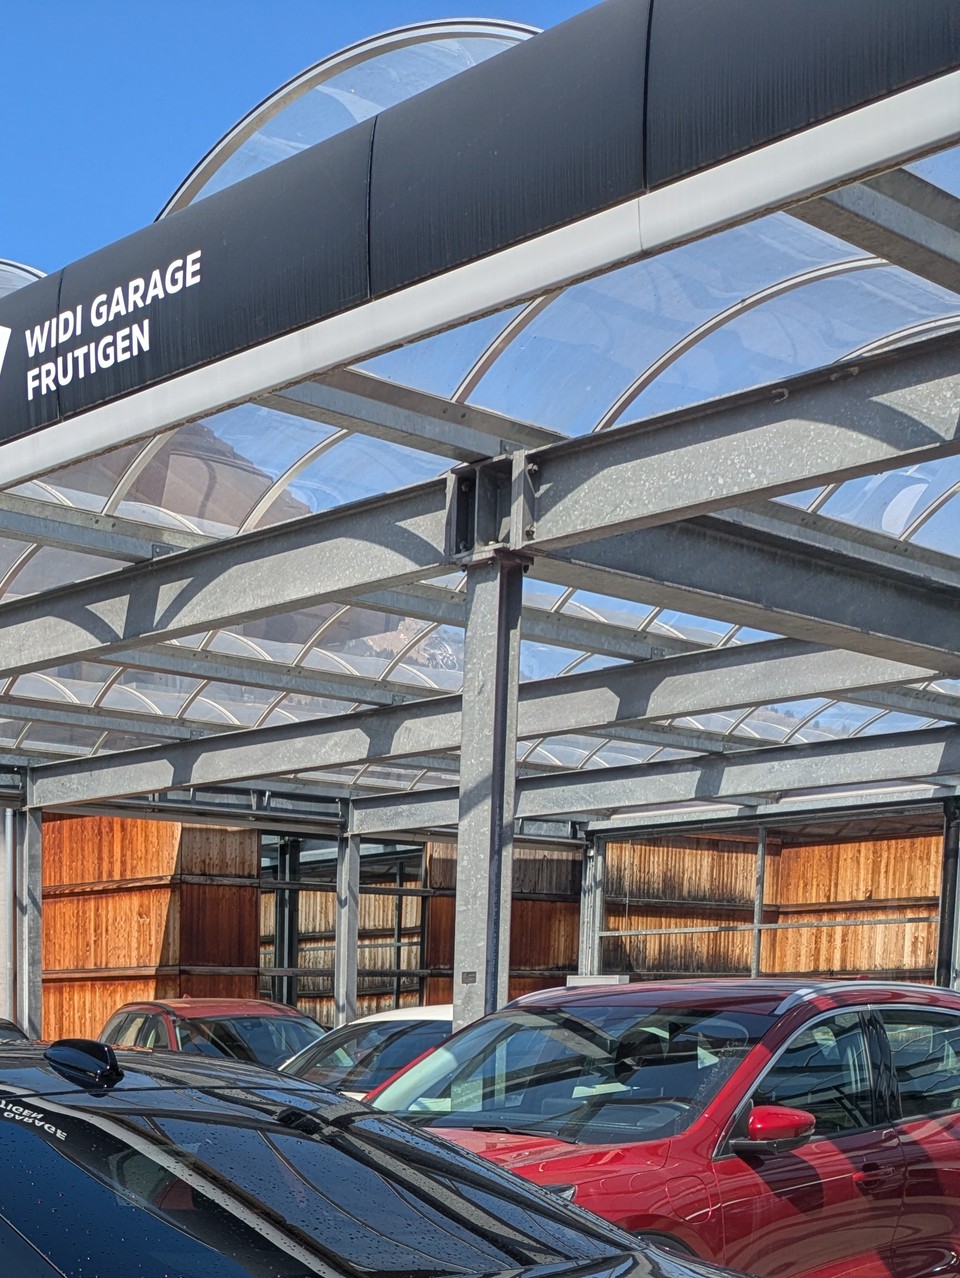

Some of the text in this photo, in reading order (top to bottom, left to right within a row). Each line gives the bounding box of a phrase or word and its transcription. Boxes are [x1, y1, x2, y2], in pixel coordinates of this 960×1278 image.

[24, 249, 202, 358] WIDI GARAGE
[26, 318, 150, 401] FRUTIGEN
